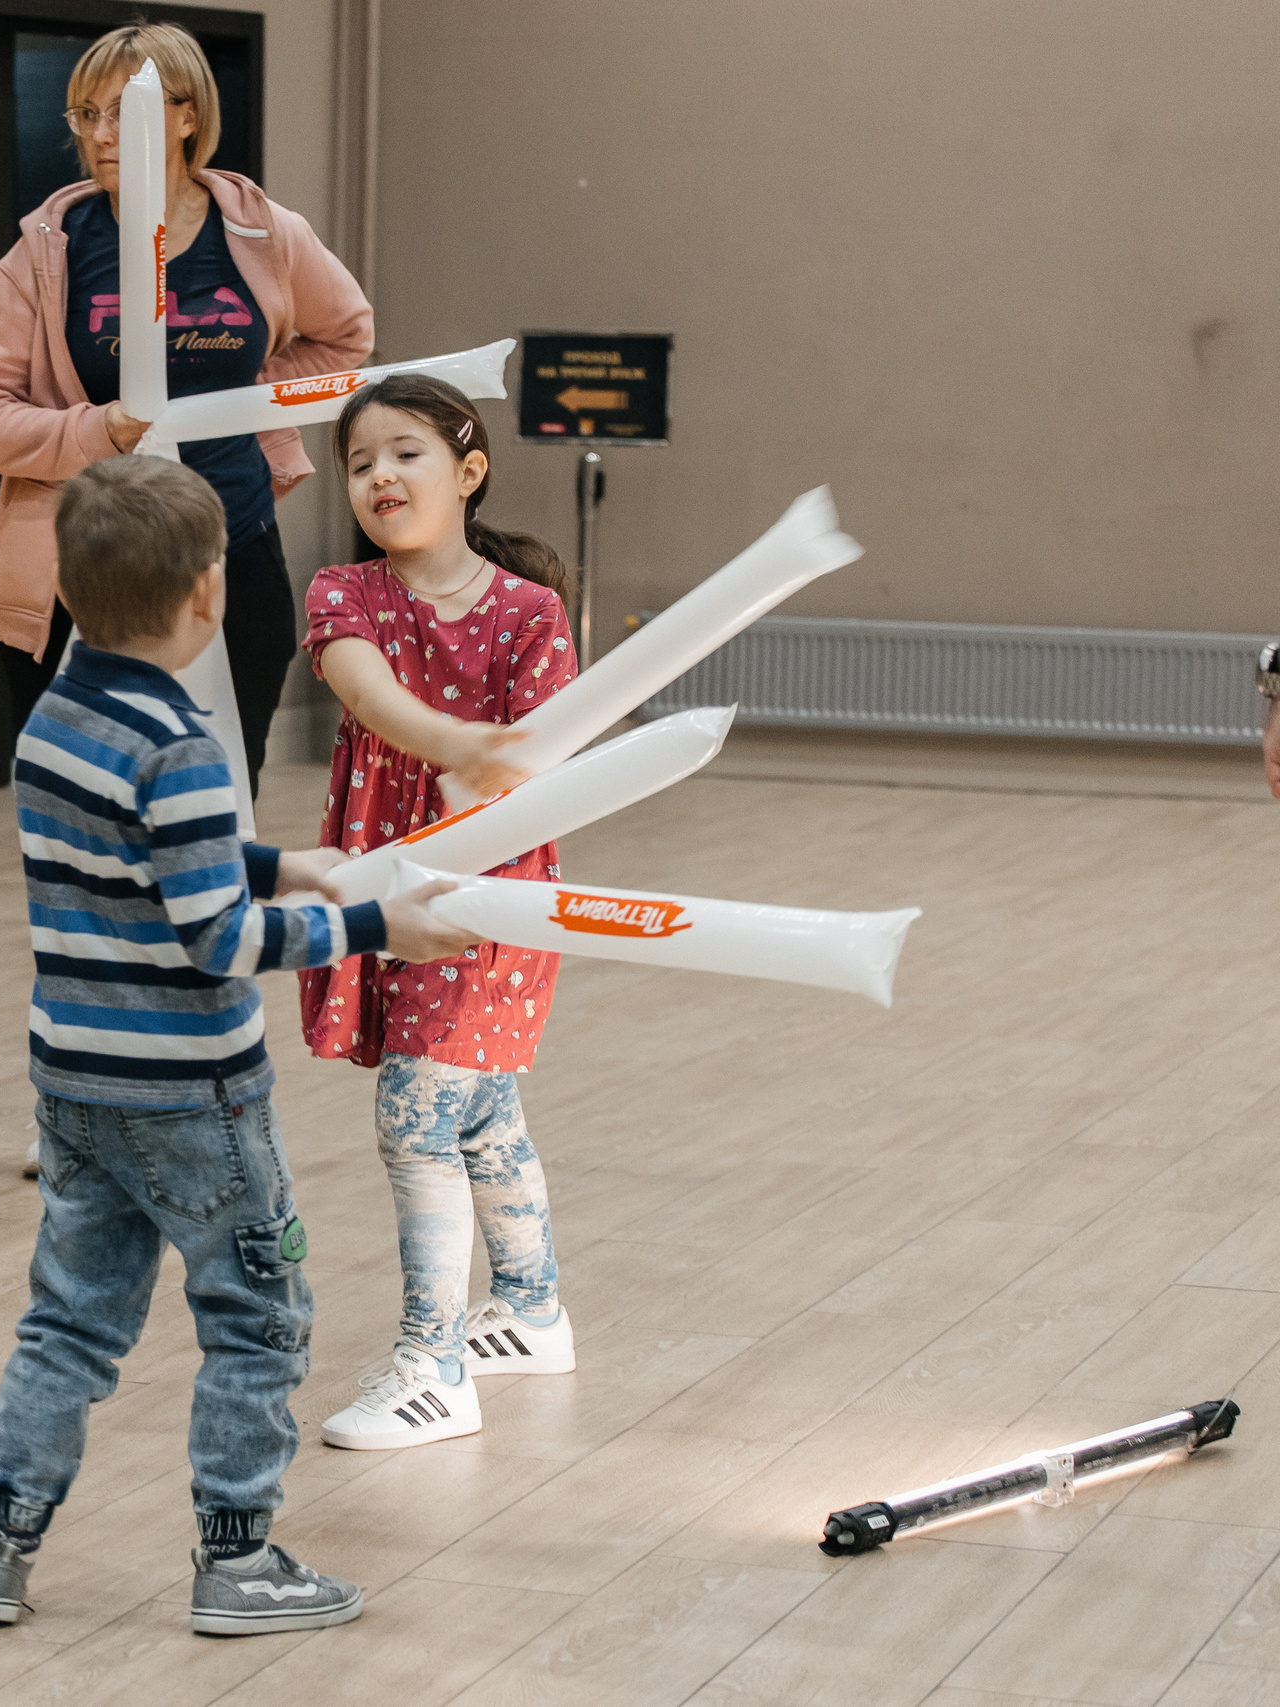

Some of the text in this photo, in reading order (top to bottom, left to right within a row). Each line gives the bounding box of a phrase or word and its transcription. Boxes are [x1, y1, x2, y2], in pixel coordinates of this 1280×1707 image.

[89, 287, 253, 333] FLA
[281, 376, 350, 397] ПЕТРОВИЧ
[564, 896, 668, 935] ПЕТРОВИЧ
